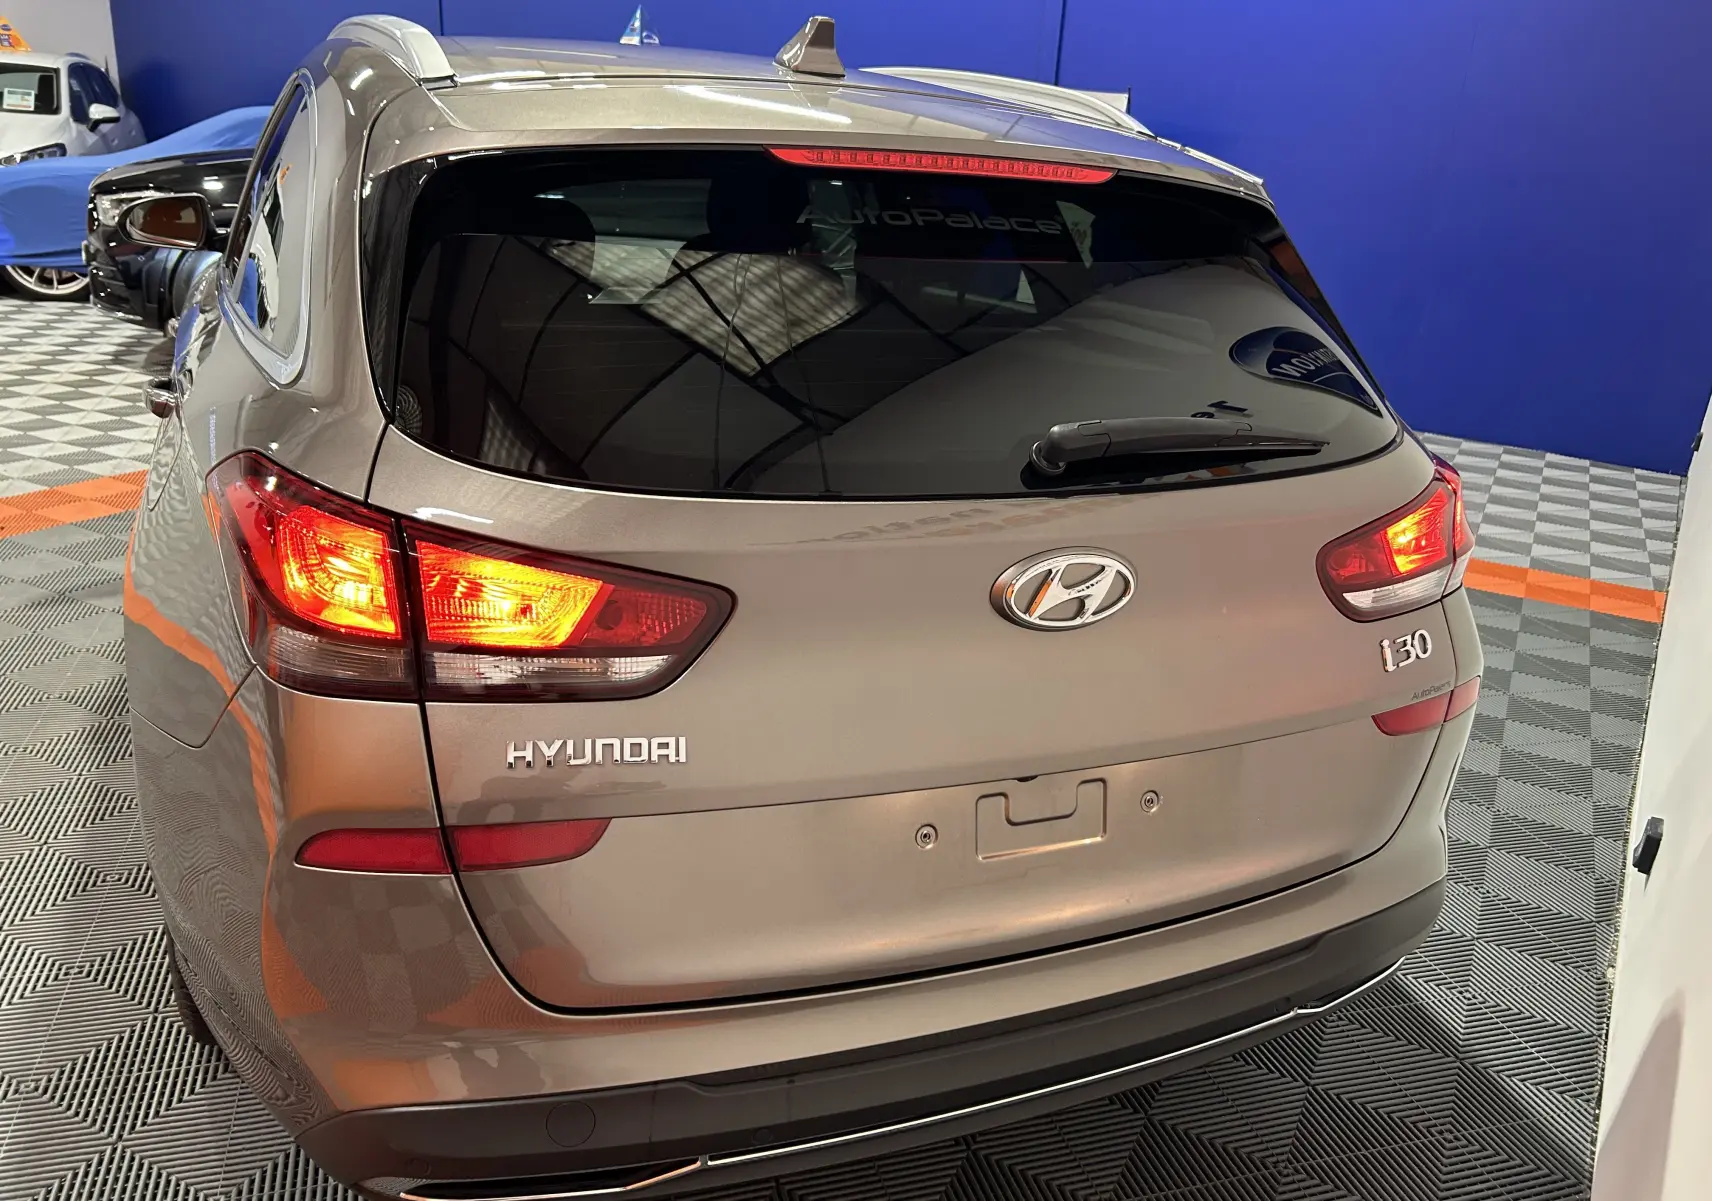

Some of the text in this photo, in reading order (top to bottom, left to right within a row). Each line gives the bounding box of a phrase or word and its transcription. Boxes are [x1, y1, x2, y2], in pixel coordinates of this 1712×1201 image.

[796, 206, 1061, 234] AutoPalace
[1380, 629, 1432, 672] i30
[506, 736, 687, 769] HYUNDAI
